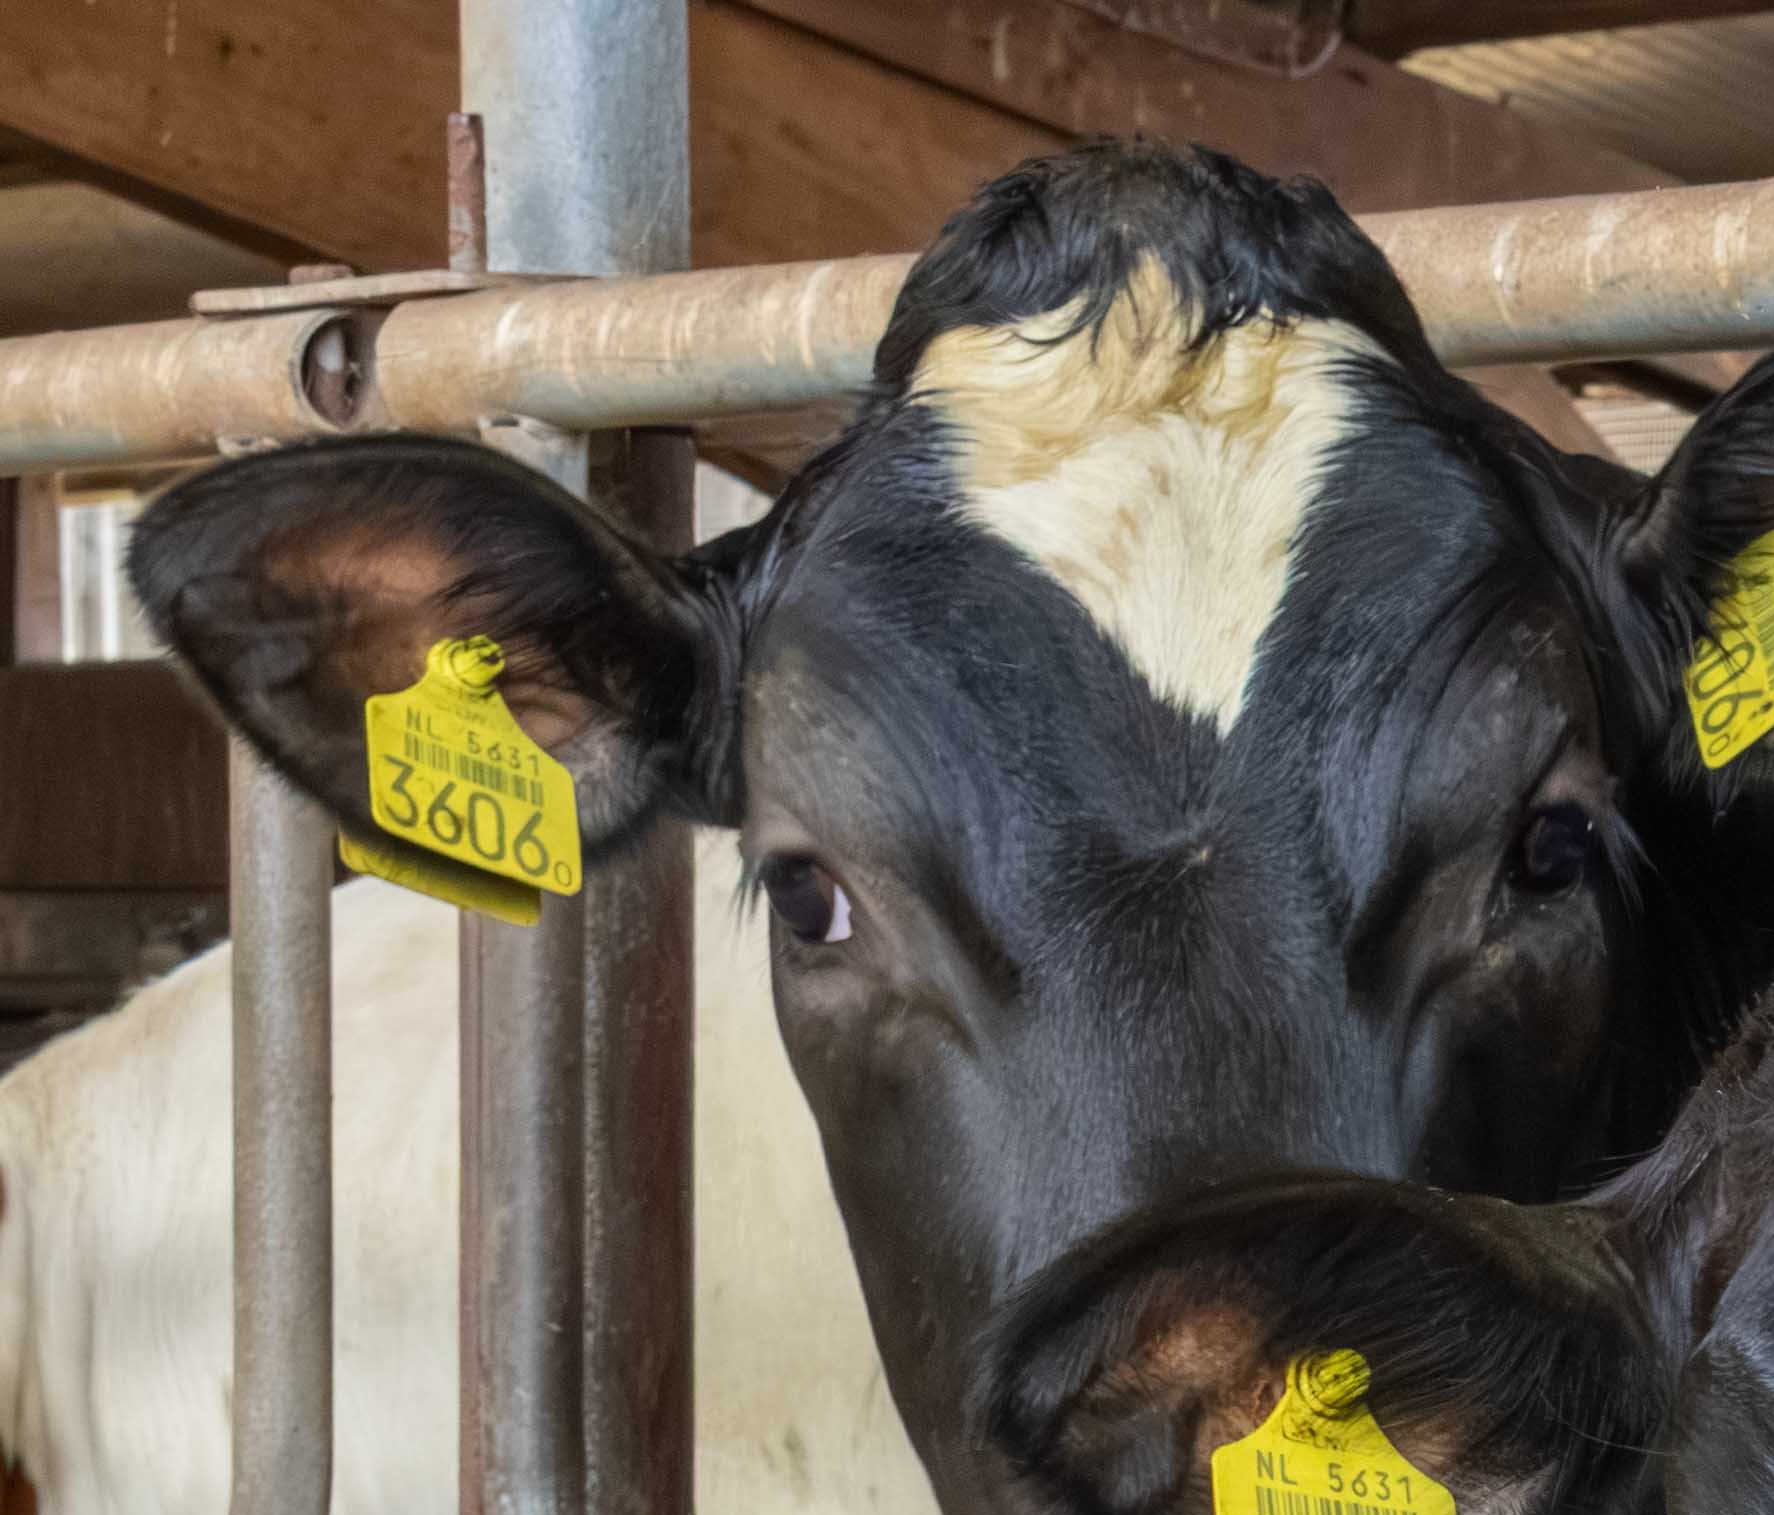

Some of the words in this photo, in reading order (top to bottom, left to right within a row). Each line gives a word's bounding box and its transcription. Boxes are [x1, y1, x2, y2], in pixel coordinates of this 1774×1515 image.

[406, 705, 441, 740] NL
[467, 731, 540, 776] 5631
[384, 754, 549, 876] 3606
[1257, 1450, 1297, 1485] NL
[1328, 1463, 1412, 1504] 5631
